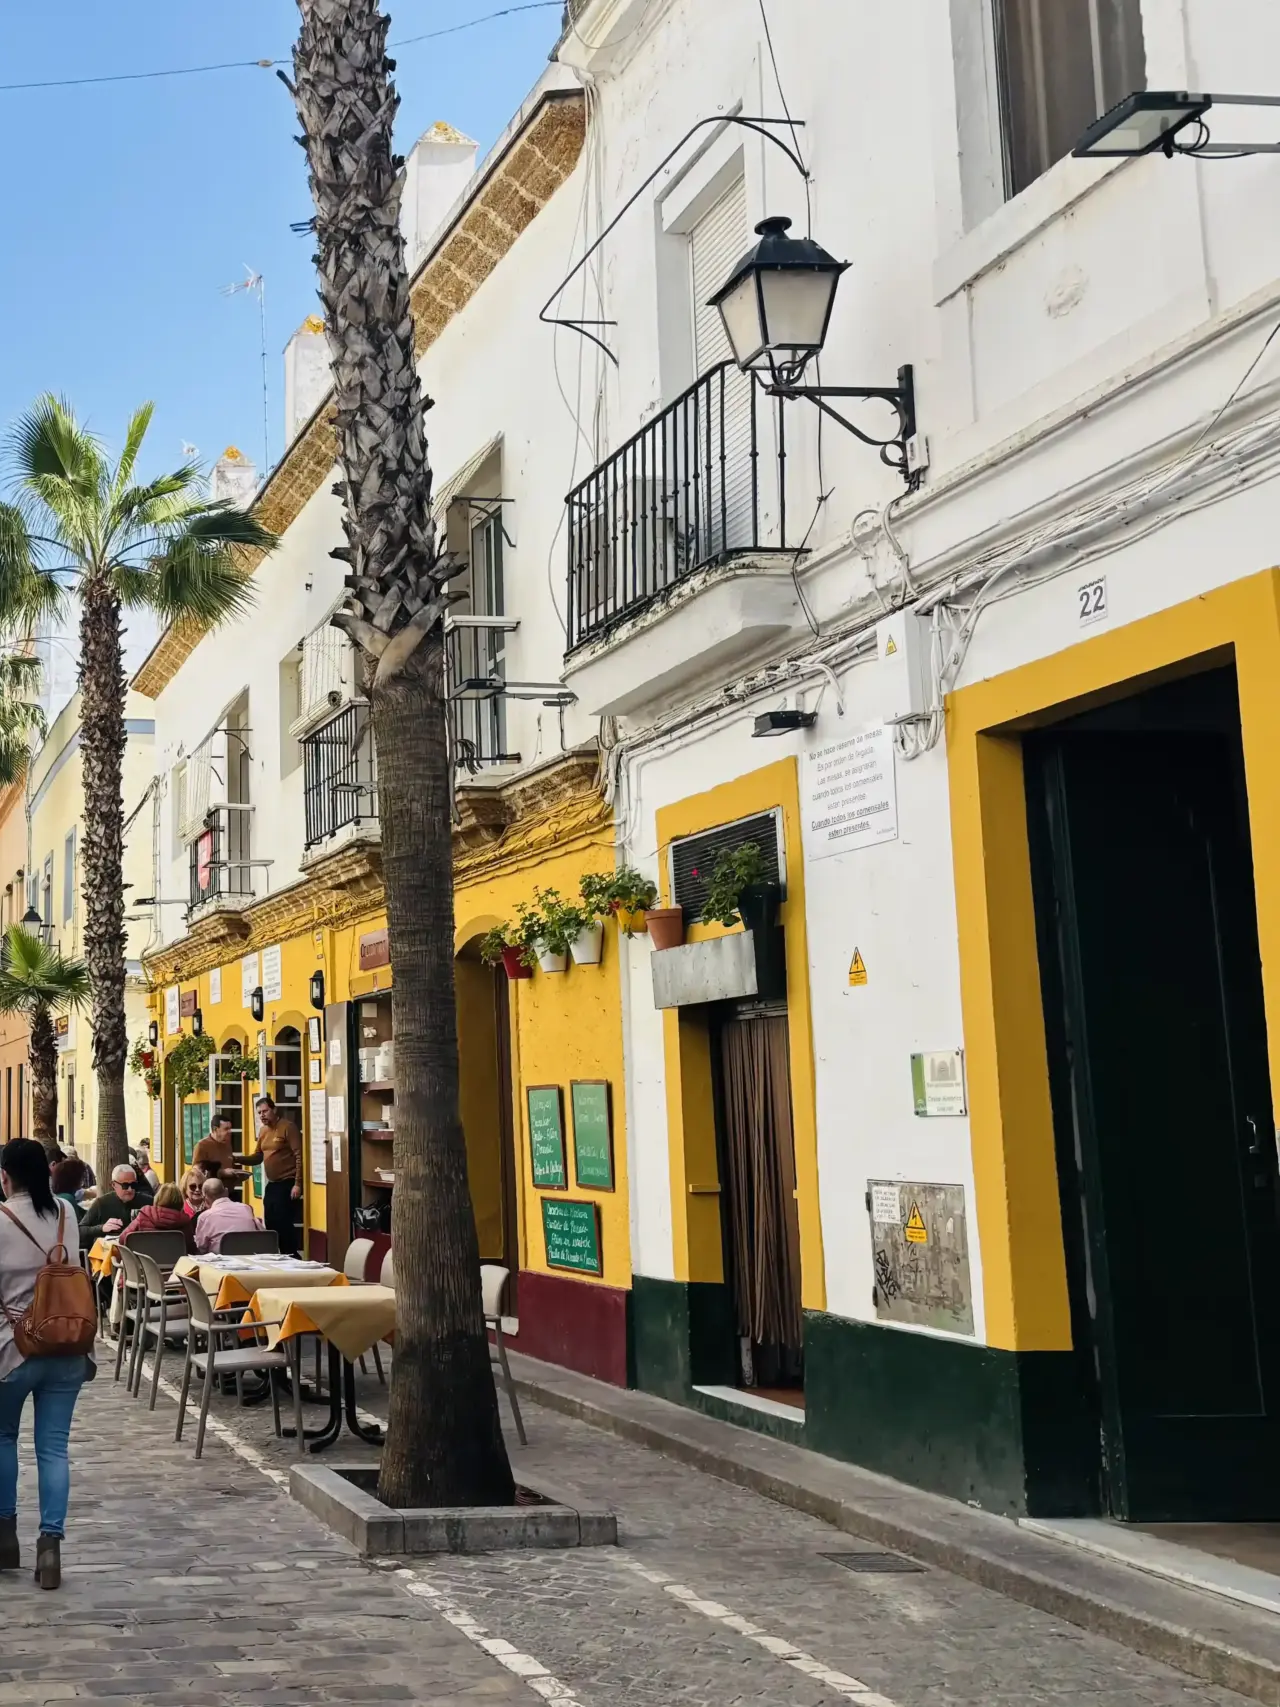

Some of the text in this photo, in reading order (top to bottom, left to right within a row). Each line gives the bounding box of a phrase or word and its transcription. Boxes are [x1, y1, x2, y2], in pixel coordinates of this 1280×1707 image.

[1079, 585, 1105, 618] 22
[809, 751, 817, 761] No
[824, 745, 836, 757] hace
[812, 817, 830, 830] Cuando
